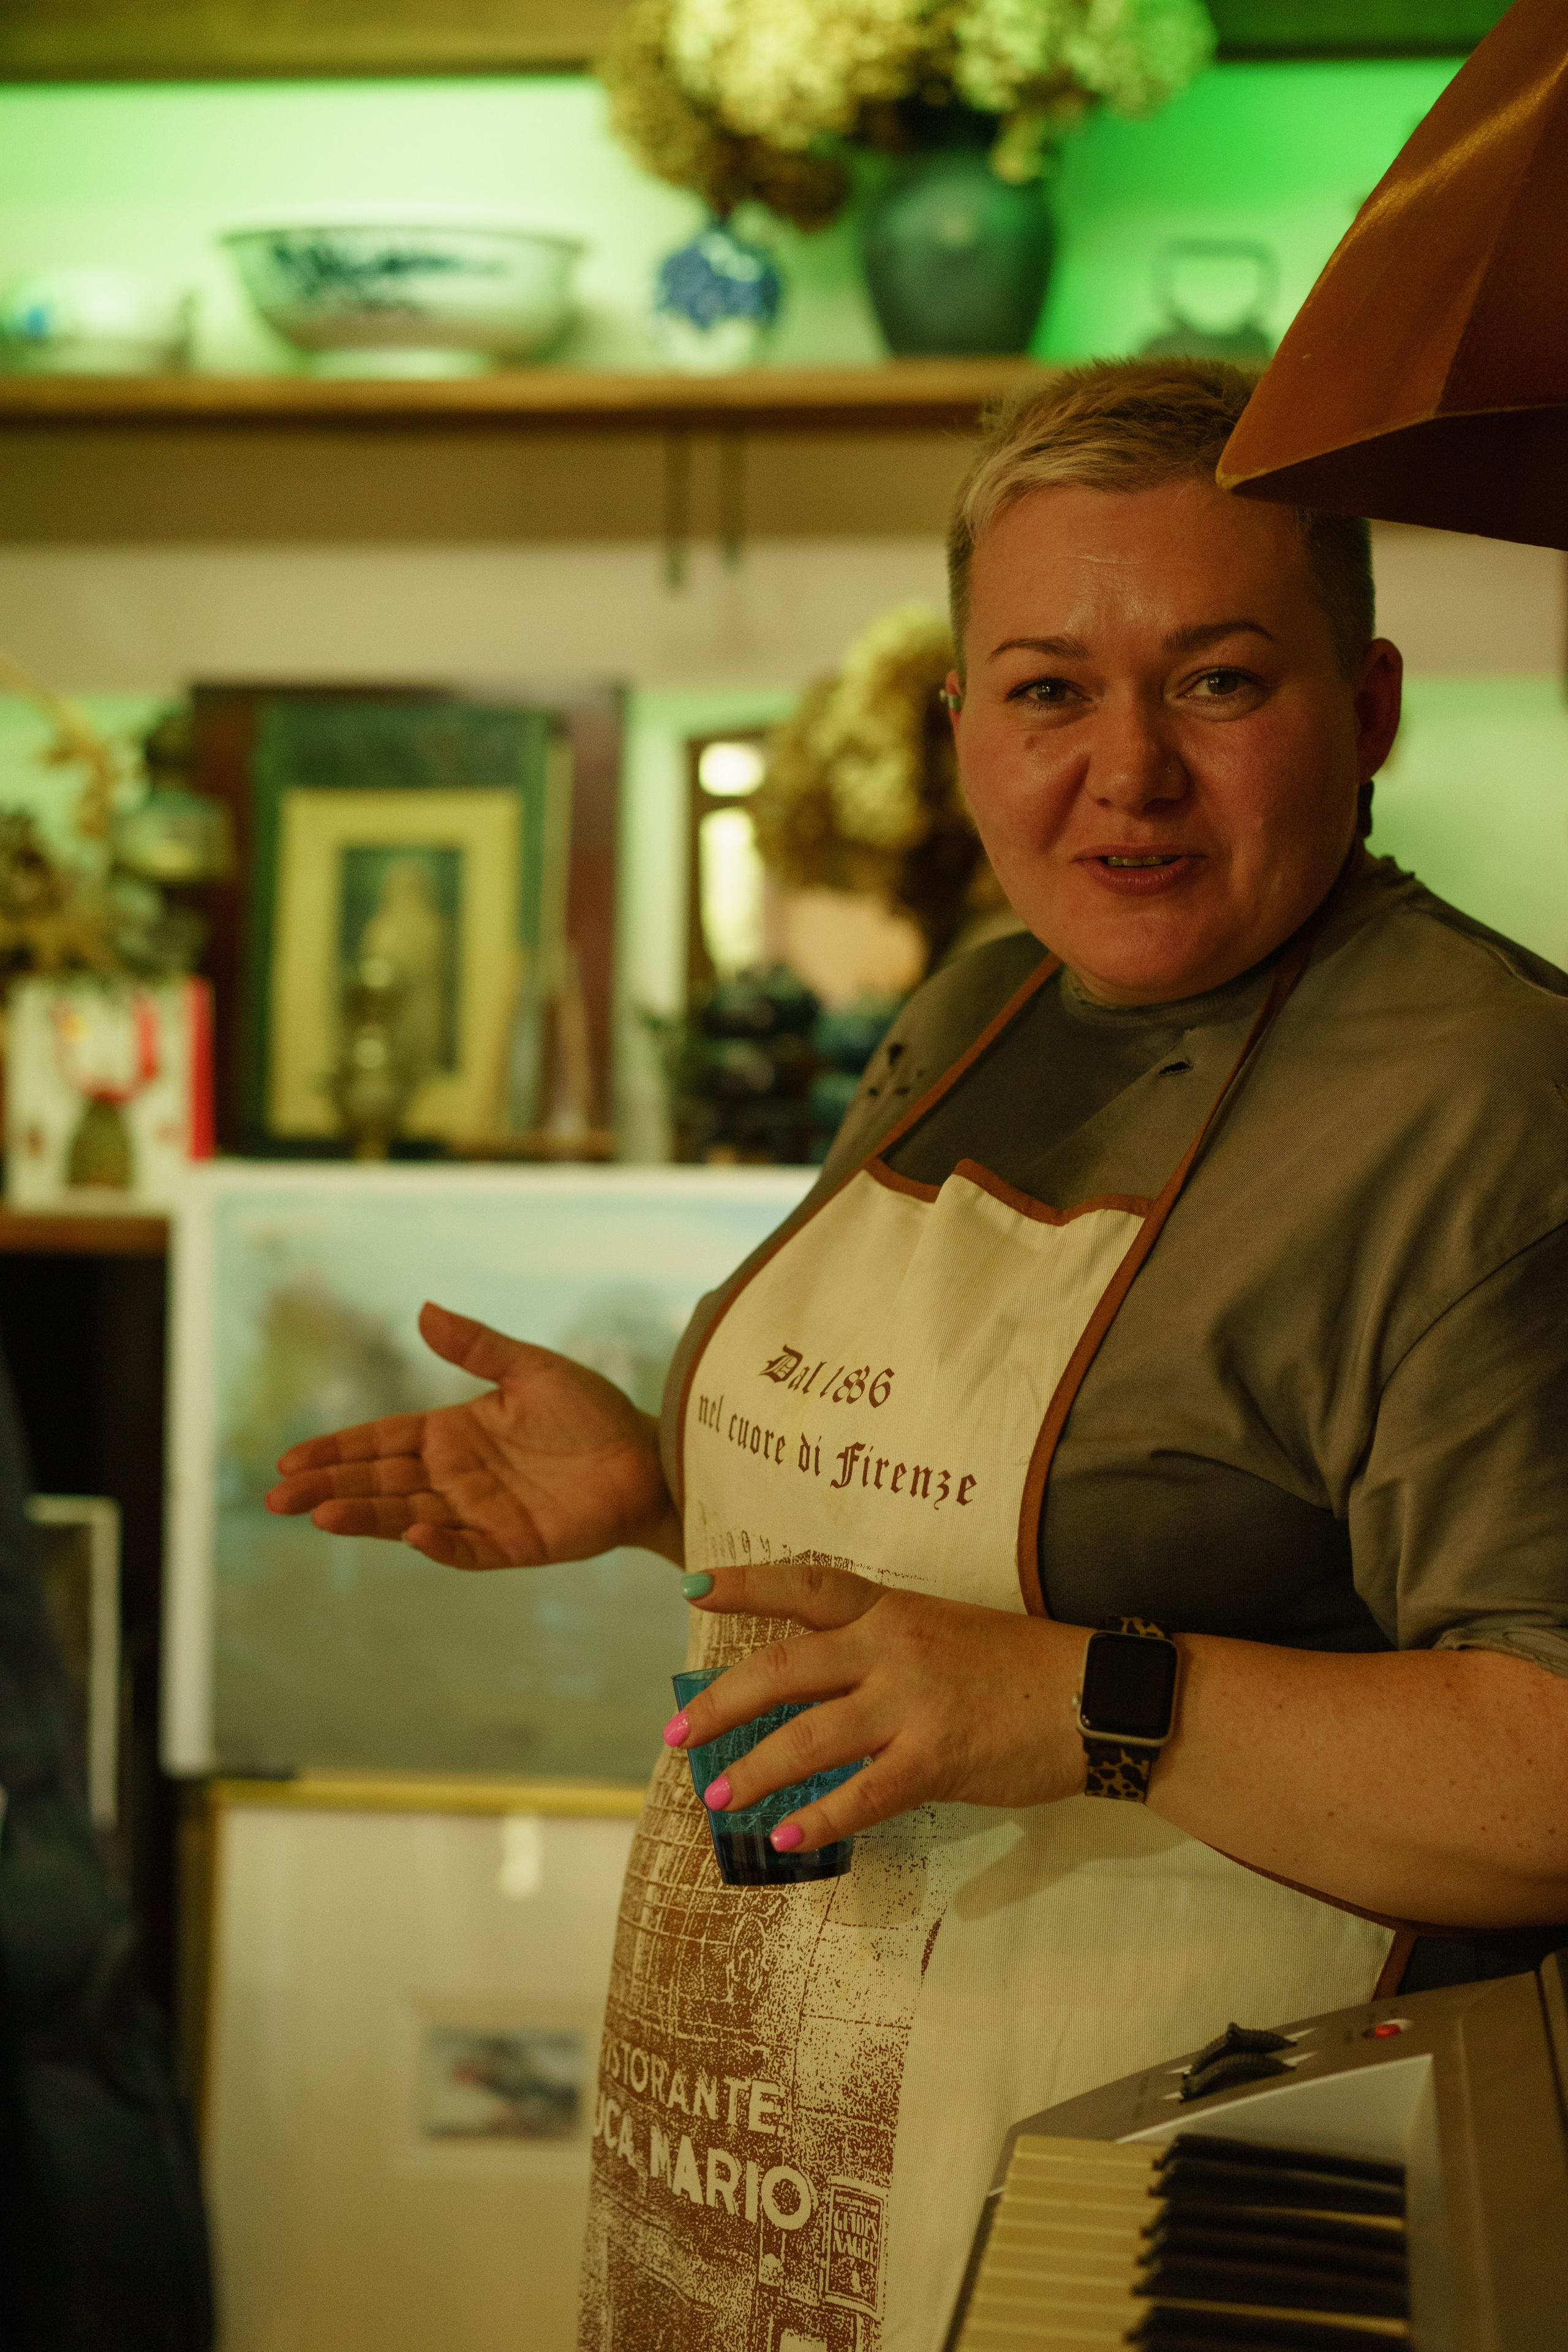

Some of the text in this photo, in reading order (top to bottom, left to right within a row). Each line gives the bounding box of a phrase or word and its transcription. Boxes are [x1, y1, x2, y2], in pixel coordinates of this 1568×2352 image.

[758, 1344, 827, 1395] Dal
[698, 1395, 977, 1510] nel cuore di Firenze
[600, 2037, 786, 2137] ISTORANTE
[650, 2122, 812, 2230] MARIO
